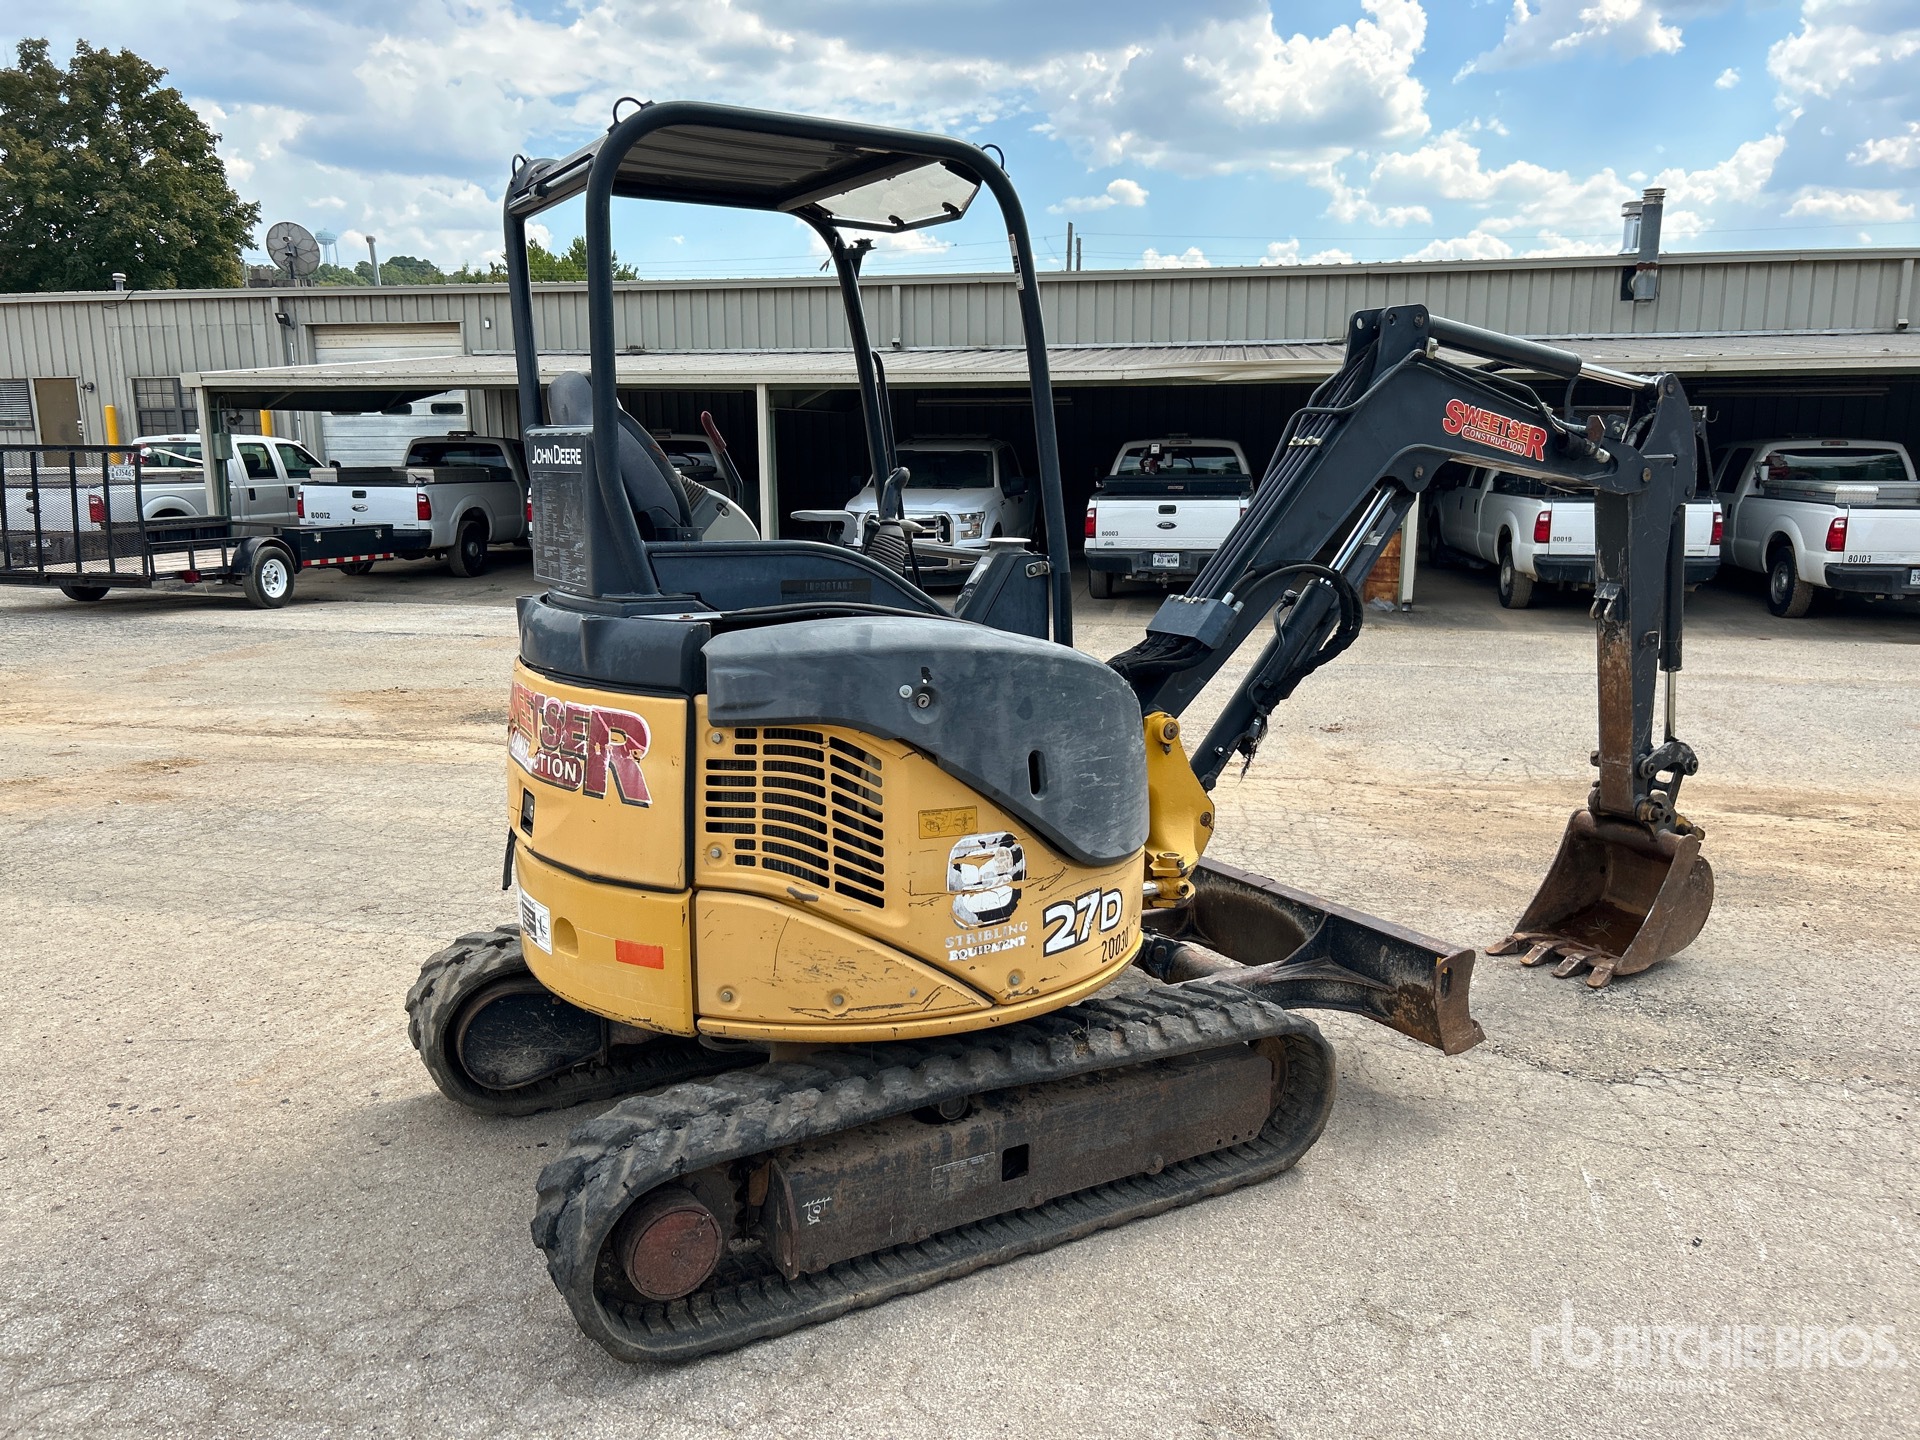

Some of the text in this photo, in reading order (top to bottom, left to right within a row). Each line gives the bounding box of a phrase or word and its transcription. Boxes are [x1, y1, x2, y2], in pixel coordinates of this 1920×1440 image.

[1442, 398, 1547, 462] SWEETSER
[1464, 428, 1525, 454] CONSTRUCTION
[532, 444, 582, 465] JOHN DEERE
[1847, 554, 1872, 563] 80103
[805, 580, 854, 592] IMPORTANT
[1043, 887, 1123, 957] 27D
[944, 921, 1029, 949] STRIBLING
[948, 936, 1027, 961] EQUIPMENT
